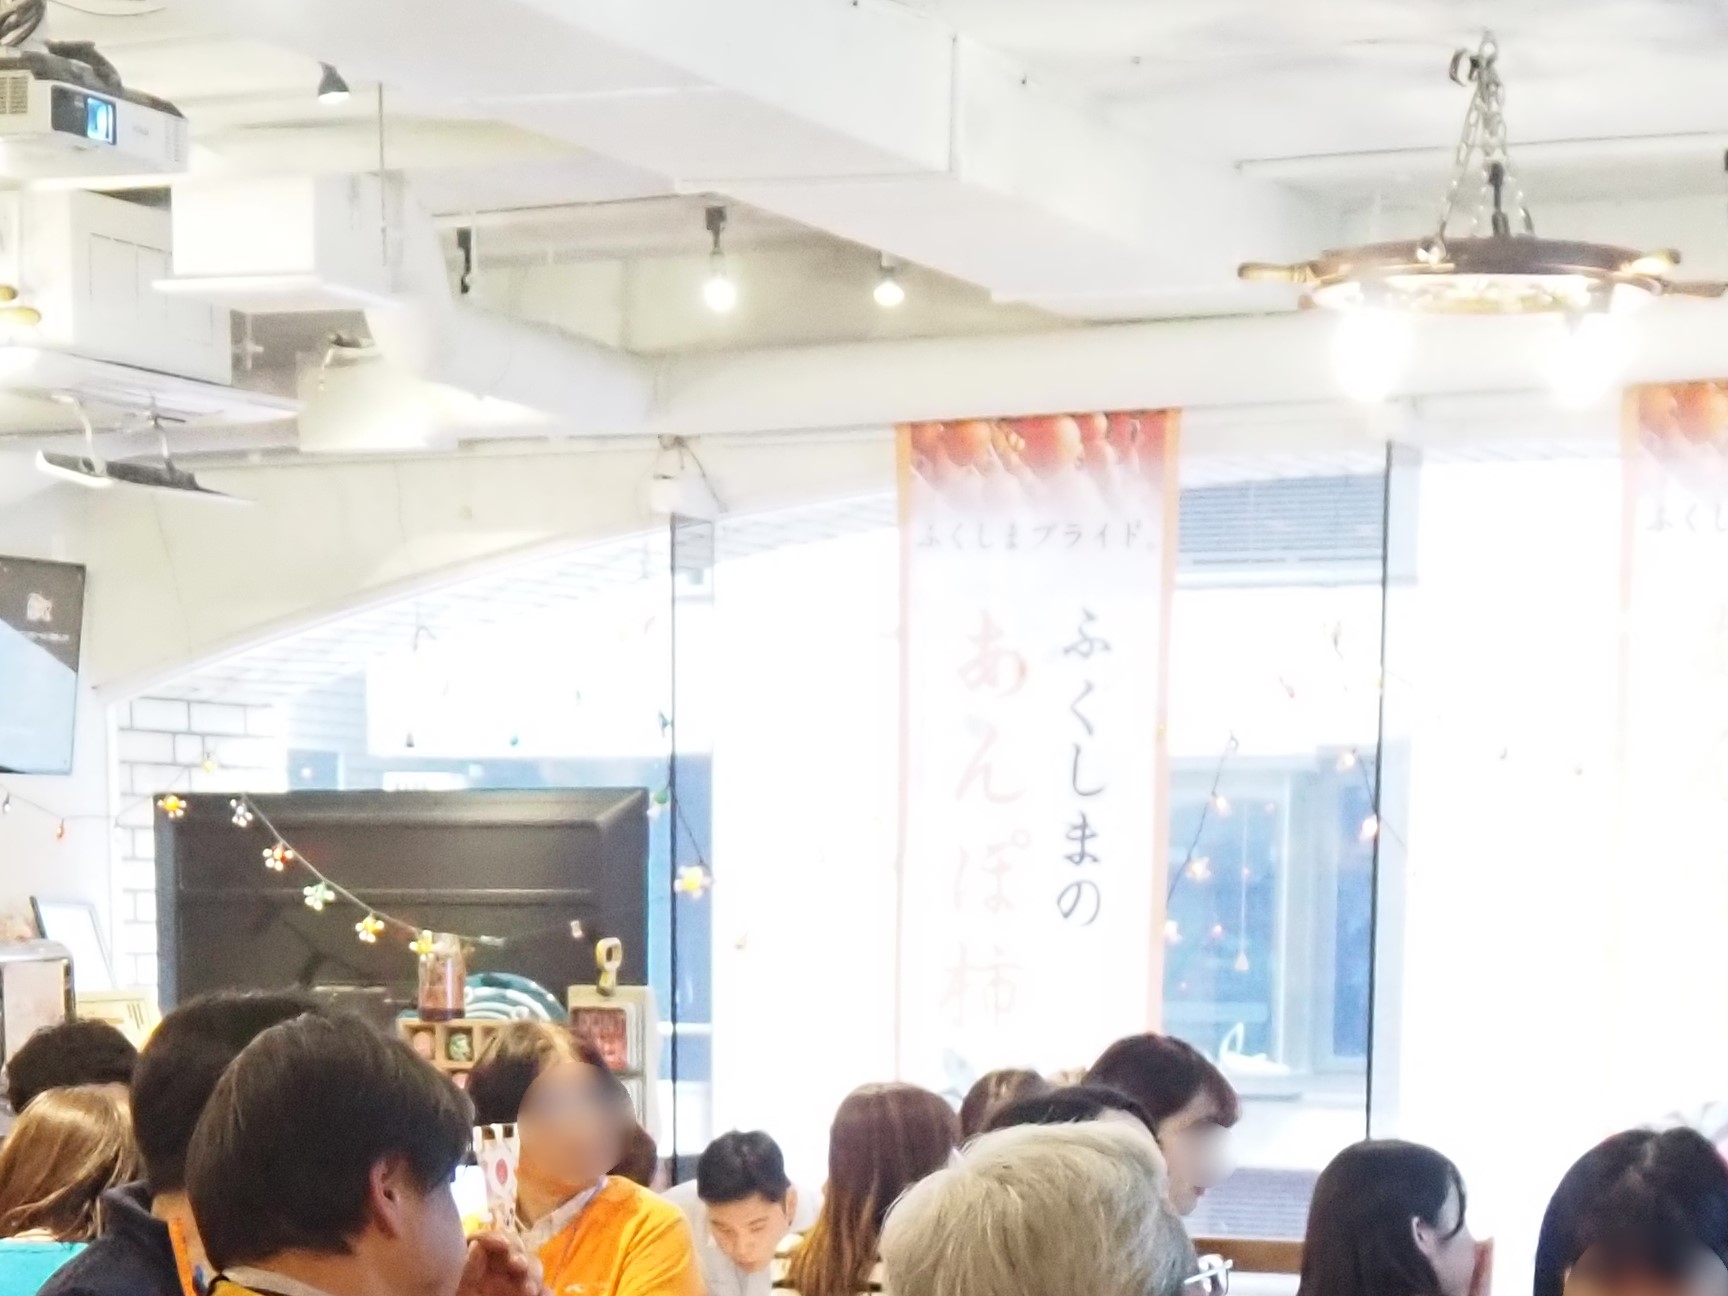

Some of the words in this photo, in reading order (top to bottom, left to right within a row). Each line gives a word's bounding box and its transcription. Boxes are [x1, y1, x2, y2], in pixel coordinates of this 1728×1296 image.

[1056, 607, 1112, 928] ふくしまの
